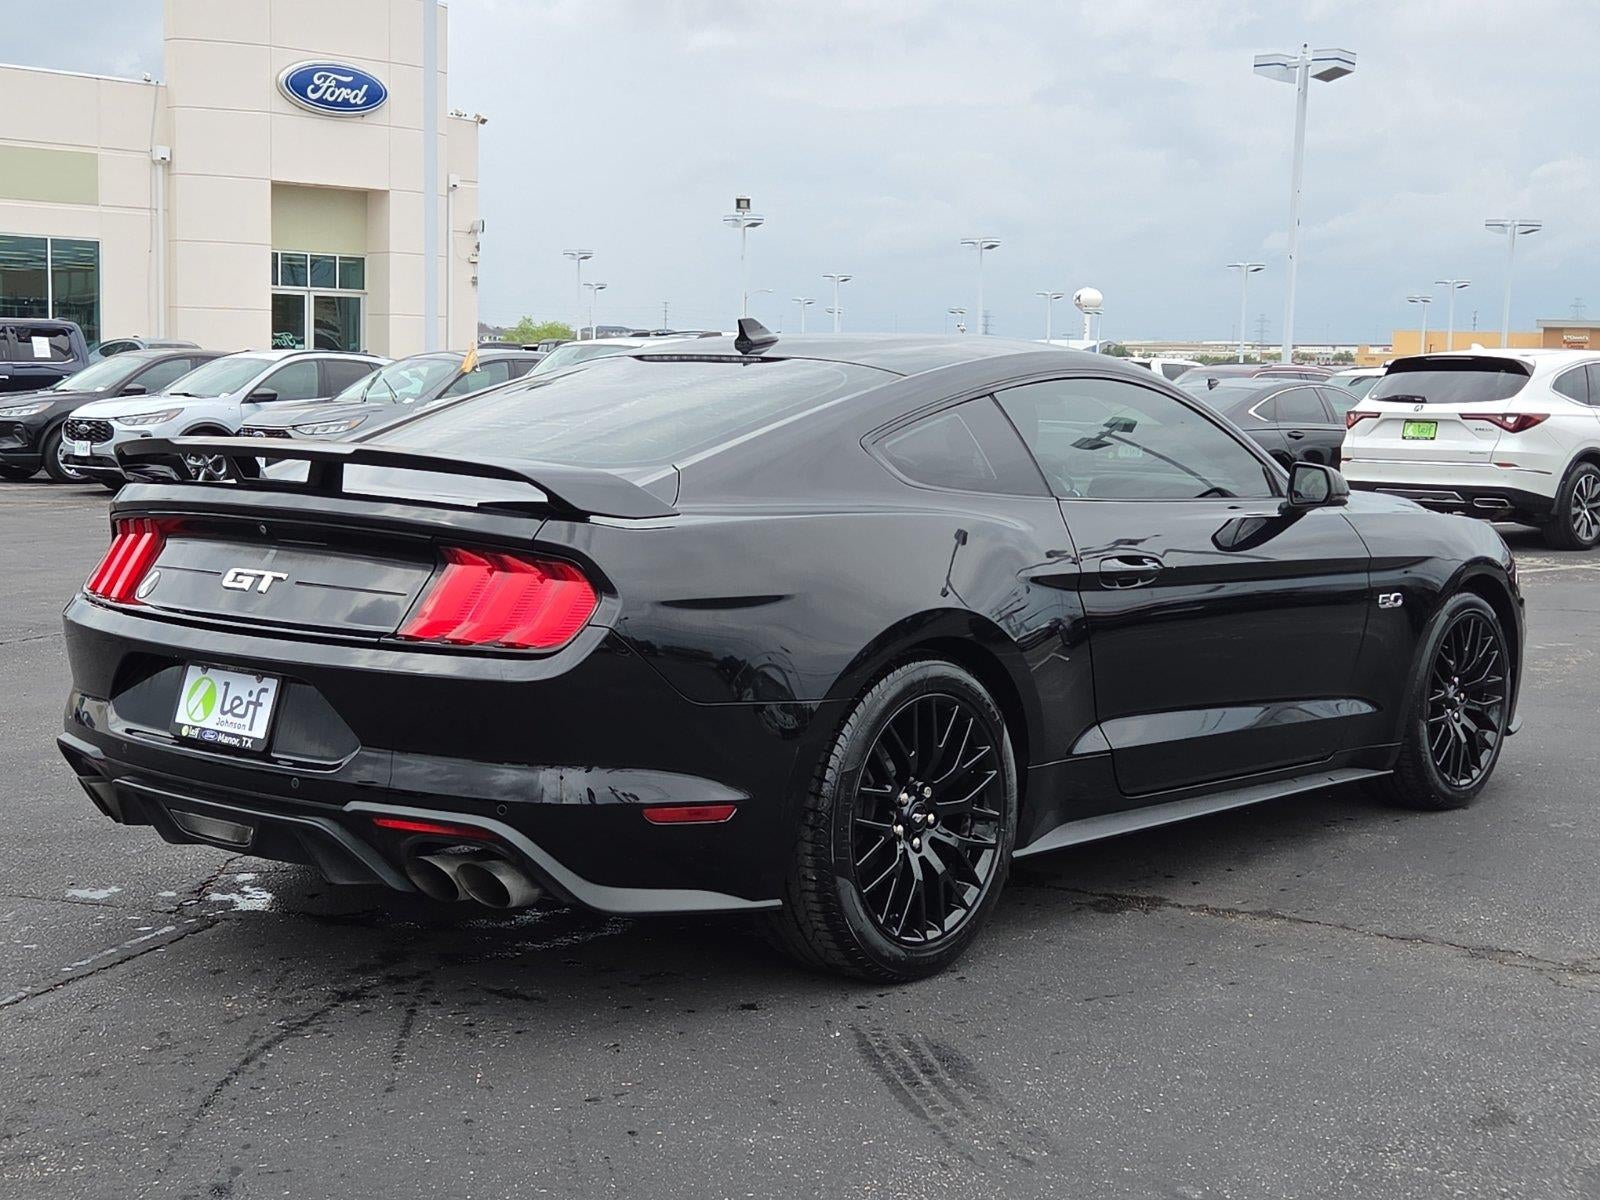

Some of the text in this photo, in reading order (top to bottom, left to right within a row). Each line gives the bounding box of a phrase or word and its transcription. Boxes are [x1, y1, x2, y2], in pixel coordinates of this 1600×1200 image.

[307, 71, 368, 104] Ford
[222, 568, 288, 594] GT
[219, 681, 269, 731] leif
[216, 717, 247, 731] Johnson
[217, 732, 240, 747] Manor,
[242, 737, 253, 748] TX
